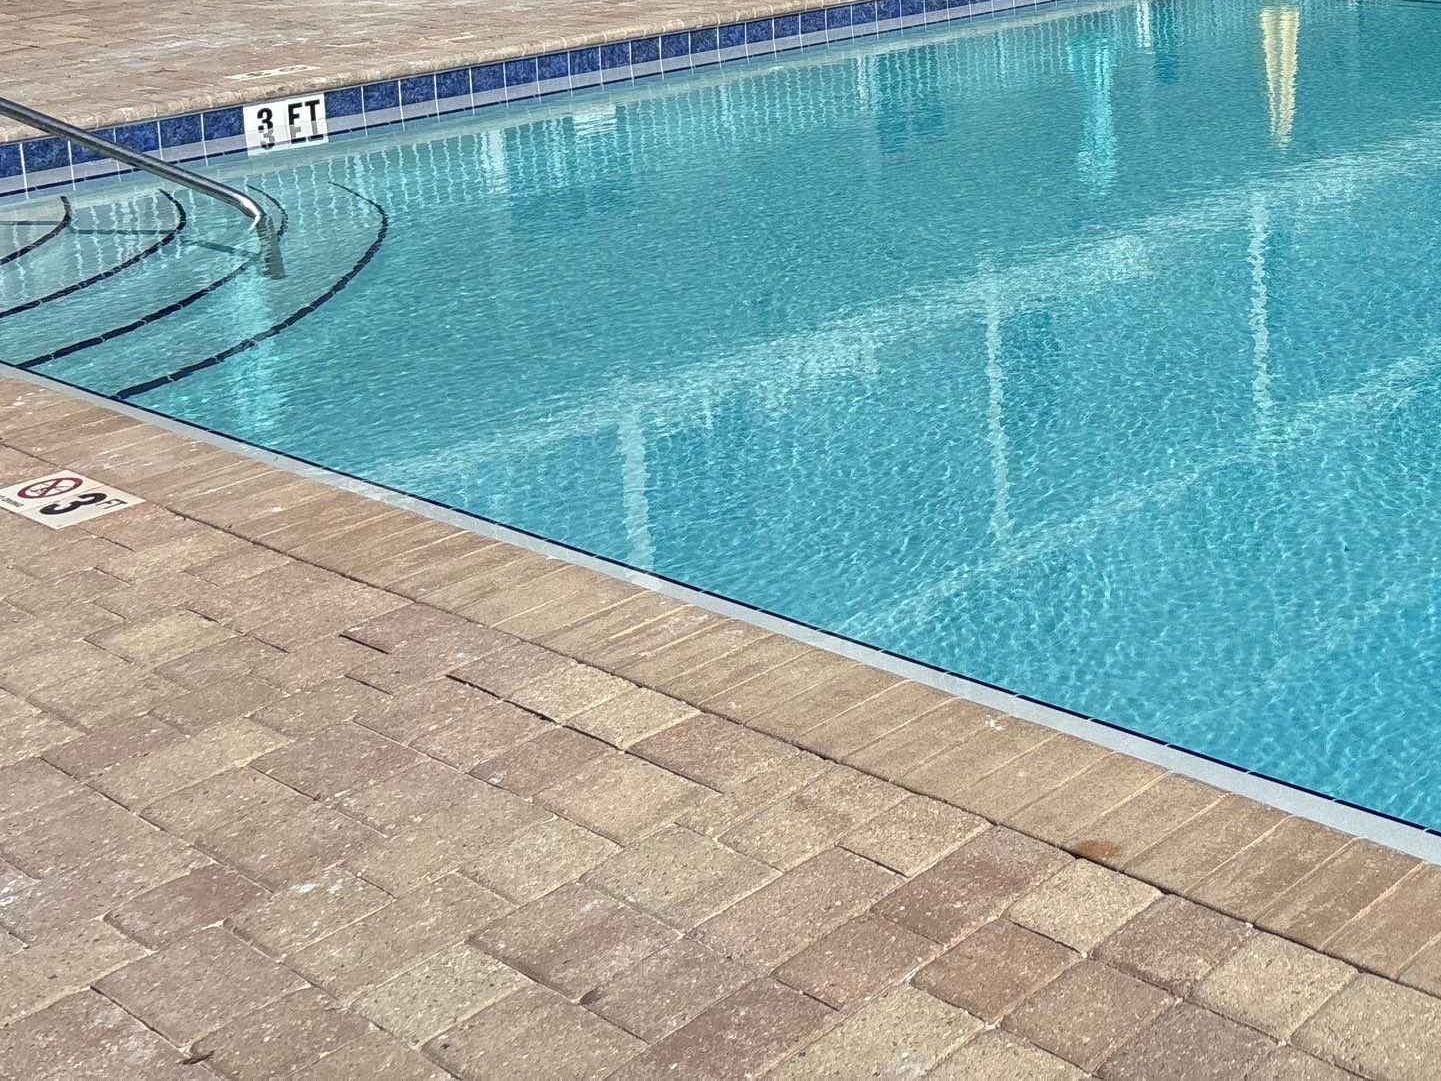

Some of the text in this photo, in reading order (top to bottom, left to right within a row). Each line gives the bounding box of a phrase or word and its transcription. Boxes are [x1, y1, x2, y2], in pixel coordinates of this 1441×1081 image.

[256, 99, 320, 131] 3 FT
[39, 492, 128, 515] 3 FT
